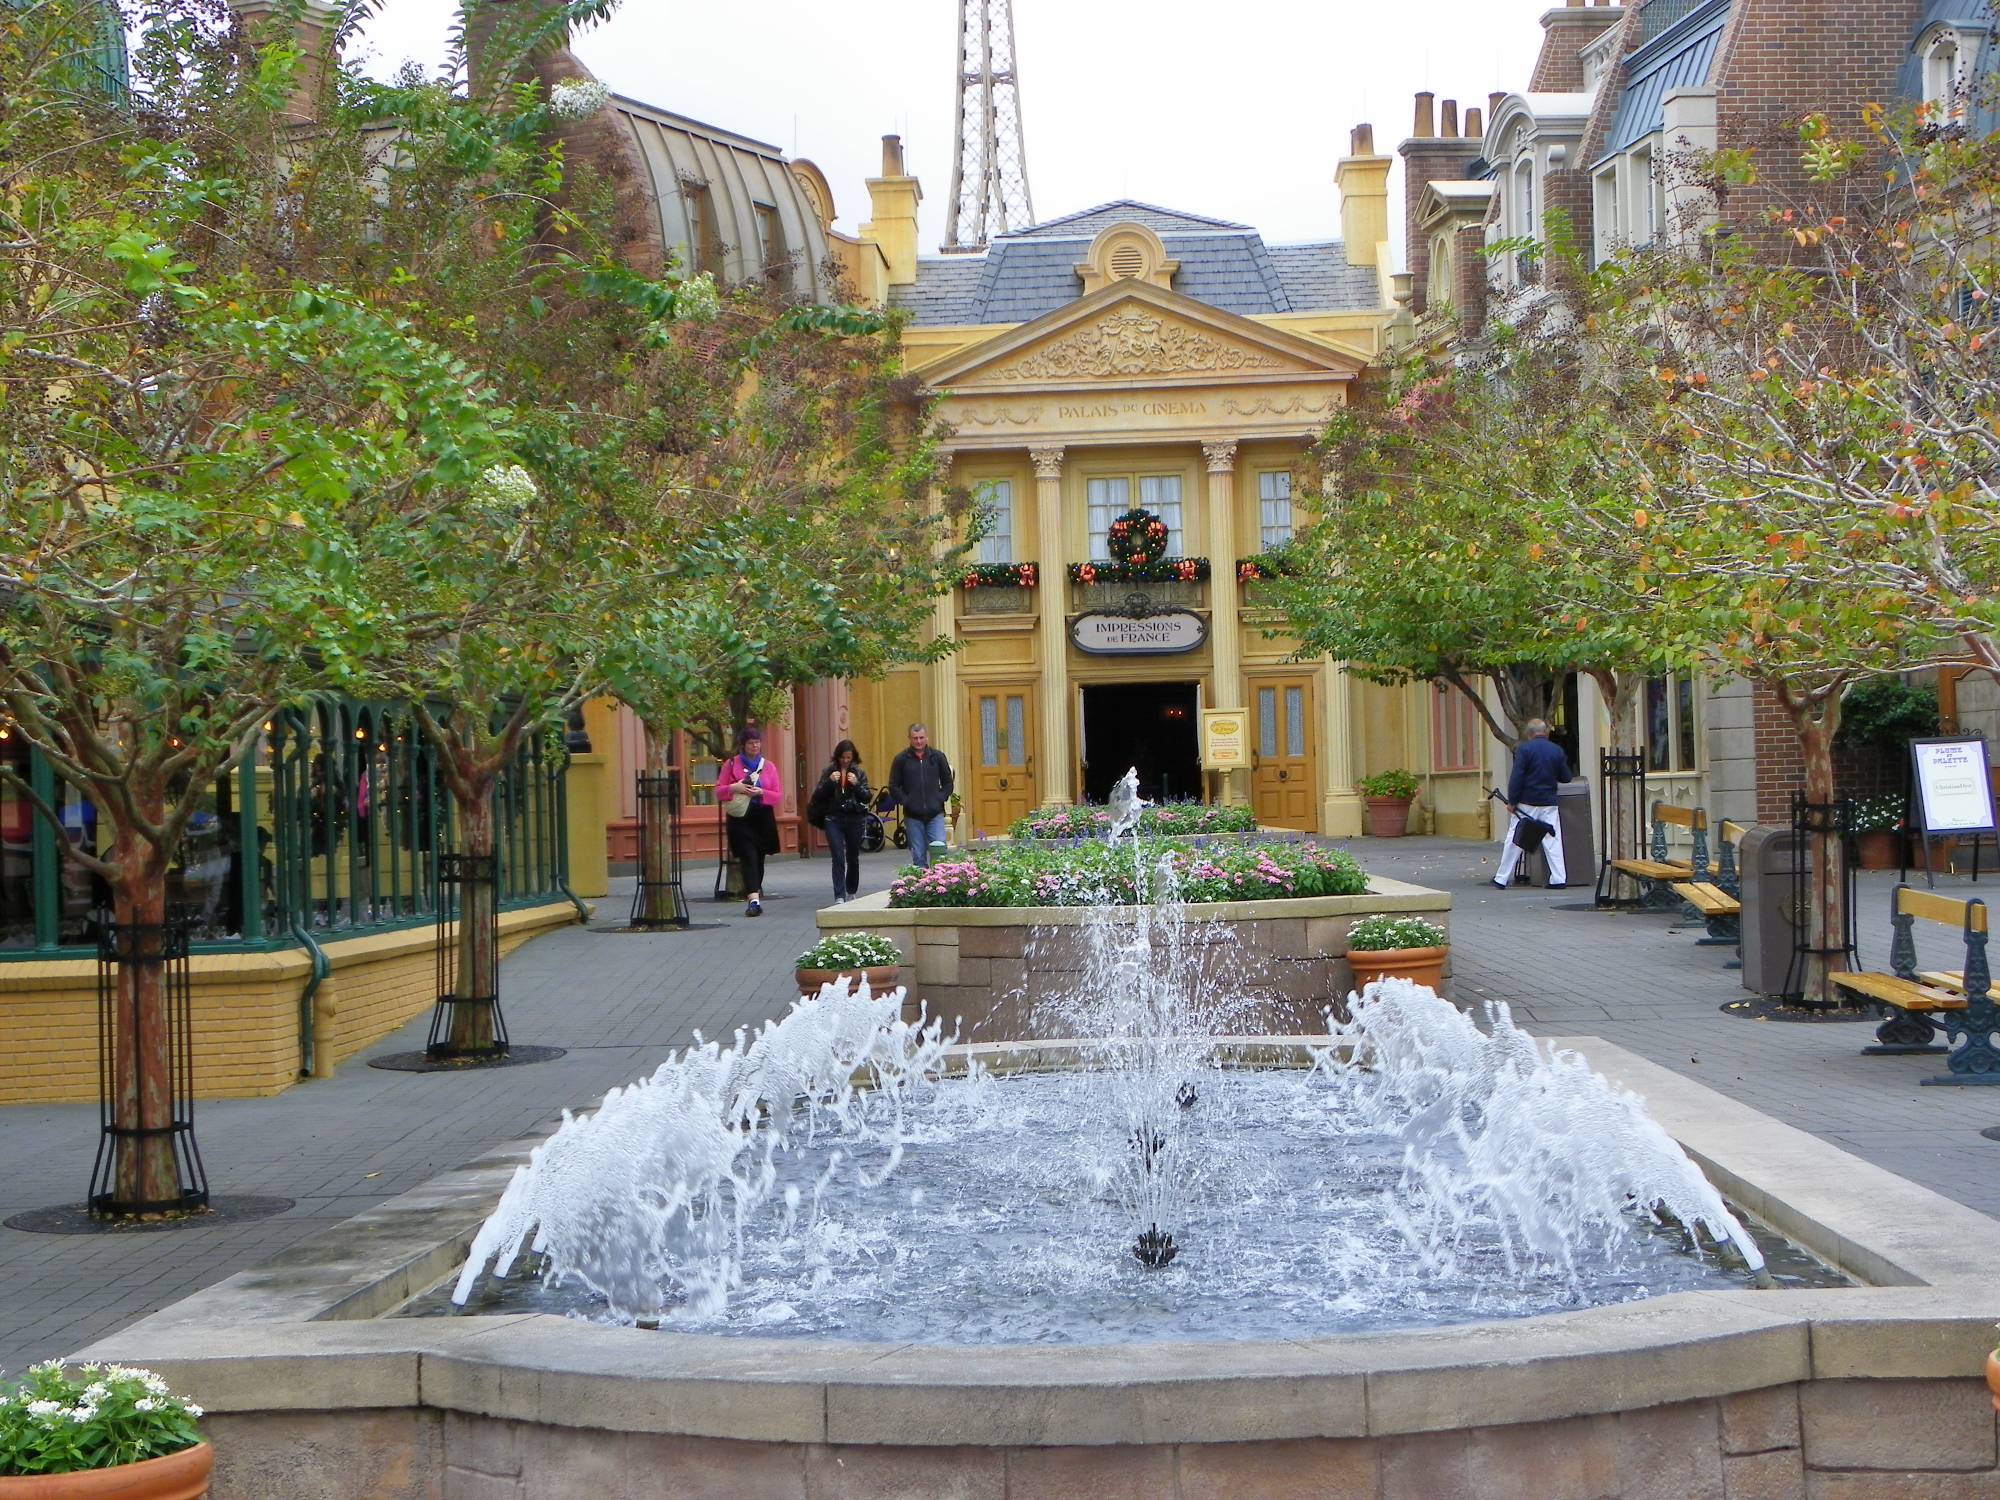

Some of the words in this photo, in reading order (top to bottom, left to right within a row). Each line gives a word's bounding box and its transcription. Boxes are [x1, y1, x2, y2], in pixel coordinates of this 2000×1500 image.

[1058, 404, 1118, 418] PALAIS
[1143, 402, 1207, 416] CINEMA
[1096, 622, 1181, 633] IMPRESSIONS
[1121, 632, 1170, 643] FRANCE
